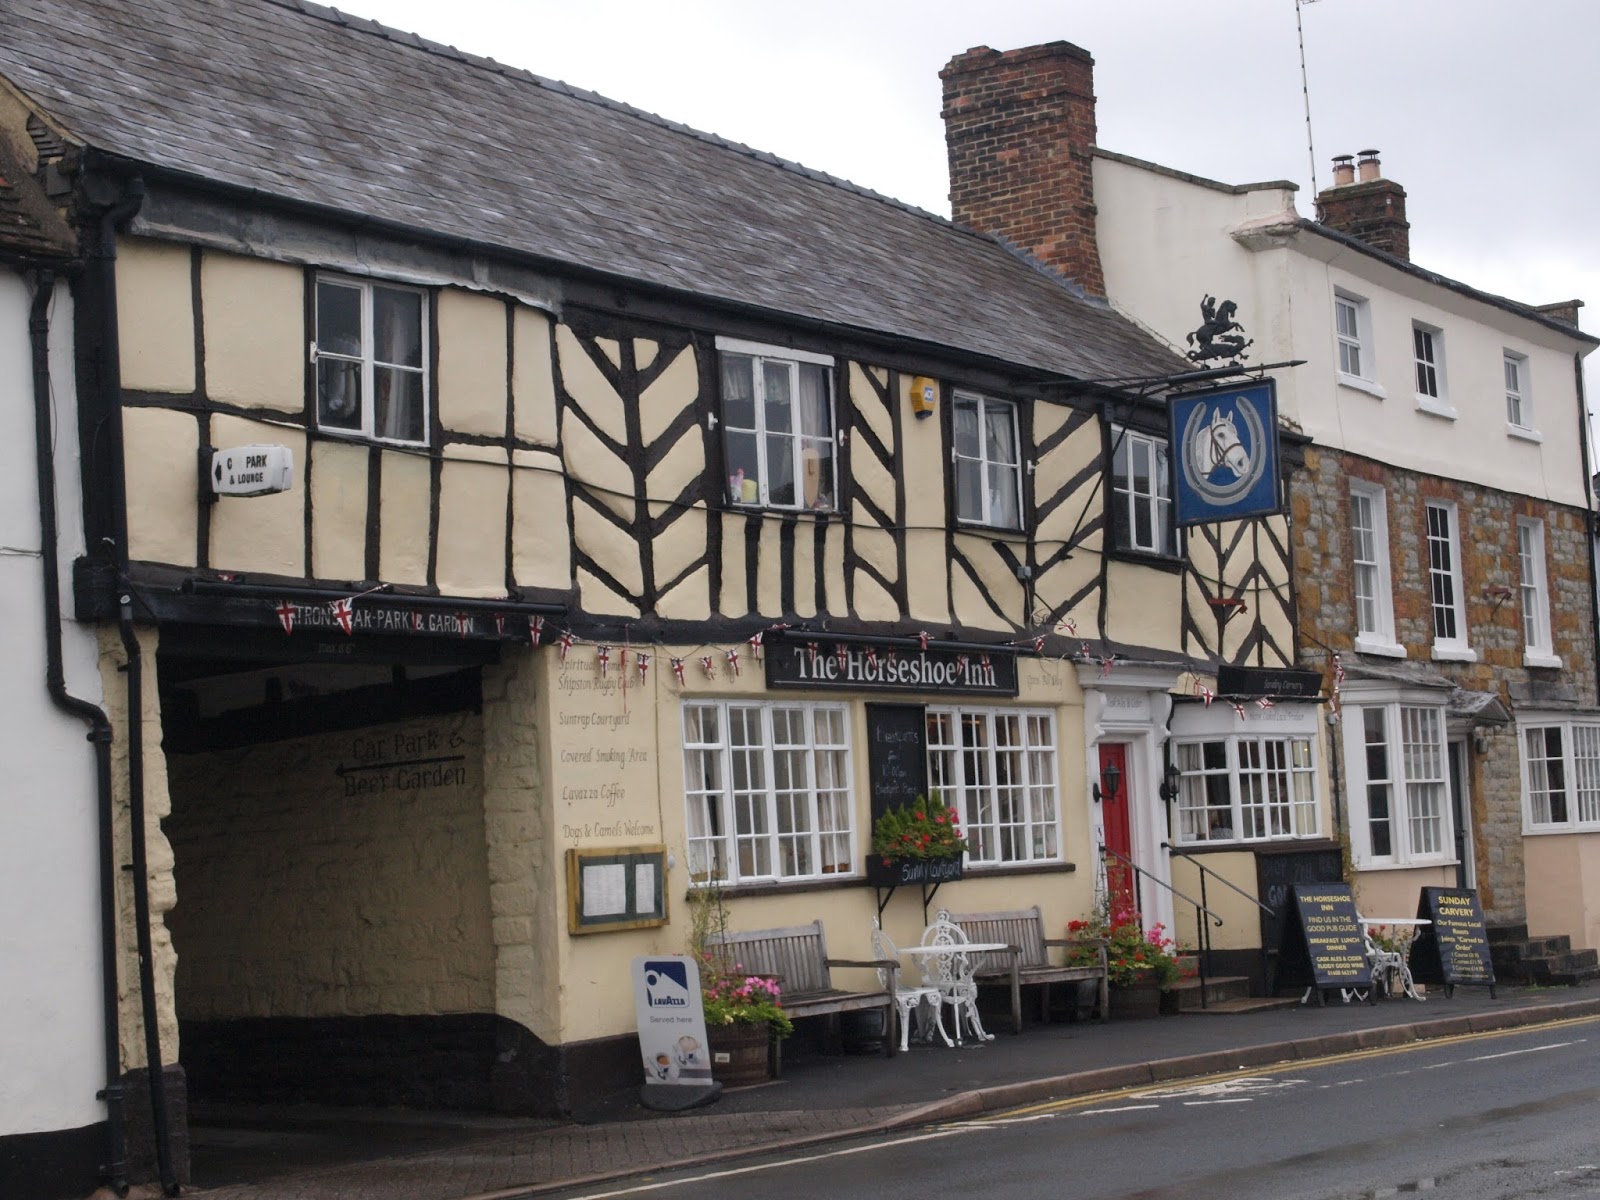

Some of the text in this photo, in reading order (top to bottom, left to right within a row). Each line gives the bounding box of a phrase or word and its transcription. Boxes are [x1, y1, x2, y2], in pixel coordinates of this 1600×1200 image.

[246, 455, 267, 468] PARK
[230, 473, 264, 485] & LOUNGE
[352, 610, 409, 629] AR-PARK
[416, 614, 425, 631] &
[793, 647, 997, 687] The Horseshoe Inn
[558, 675, 591, 696] Shipston
[593, 676, 617, 696] Rugby
[559, 711, 631, 731] Suntrap Courtyard
[352, 737, 385, 760] Car
[394, 729, 438, 755] Park
[561, 747, 647, 769] Covered Smoking Area
[344, 764, 466, 797] Beer Garden
[562, 783, 625, 807] Lavazza Coffee
[562, 819, 654, 846] Dogs & Camels Welcome
[902, 863, 928, 881] Sunny
[1313, 895, 1351, 903] HORSESHOE
[1438, 896, 1470, 905] SUNDAY
[1439, 907, 1474, 916] CARVERY
[654, 996, 685, 1005] LAVAZZA
